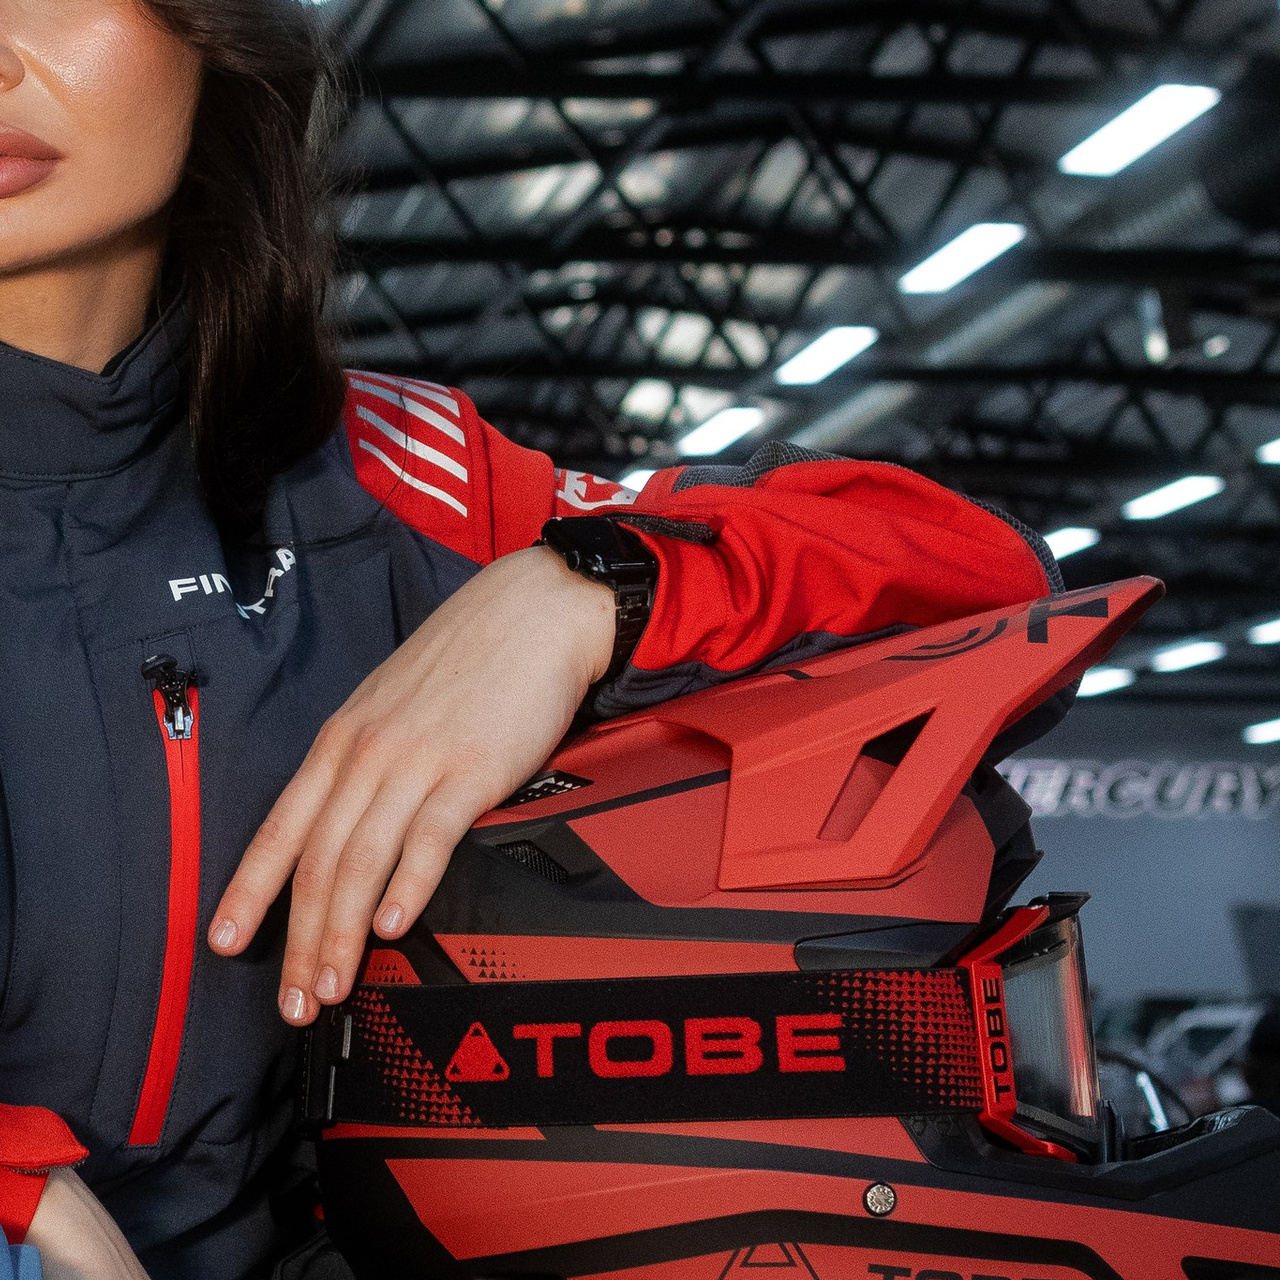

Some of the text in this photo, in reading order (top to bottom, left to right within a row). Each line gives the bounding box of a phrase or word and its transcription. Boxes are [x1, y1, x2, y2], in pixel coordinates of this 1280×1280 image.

[995, 759, 1280, 820] ERCURY
[513, 1013, 846, 1078] TOBE
[982, 977, 1011, 1103] TOBE
